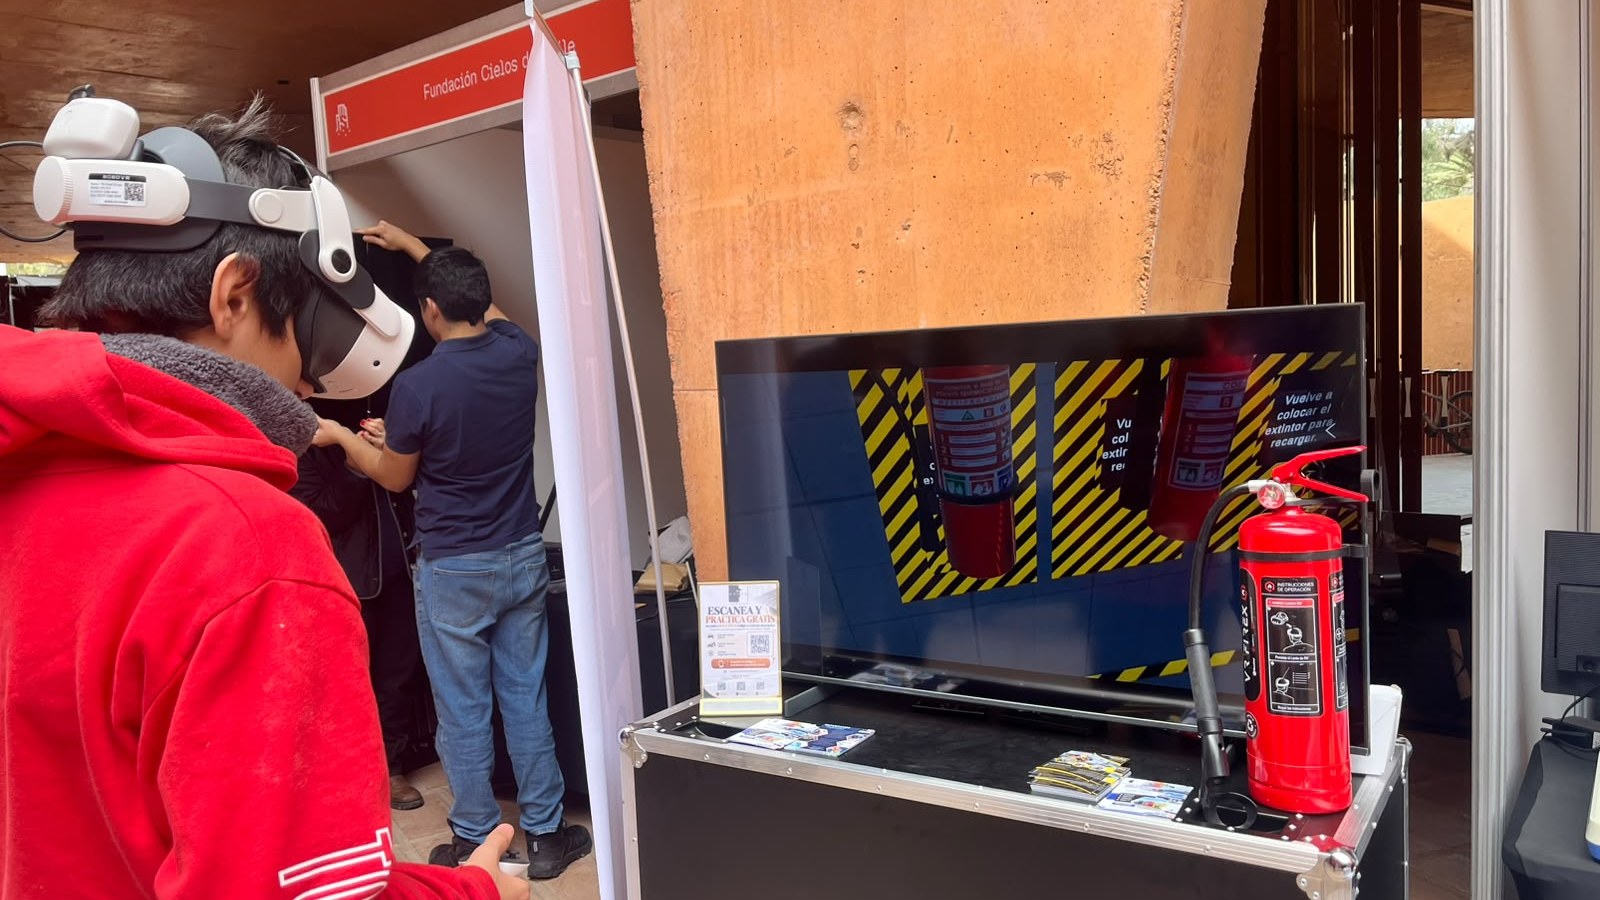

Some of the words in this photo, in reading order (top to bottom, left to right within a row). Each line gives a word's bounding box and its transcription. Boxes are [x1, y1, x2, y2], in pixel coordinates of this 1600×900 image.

[423, 70, 478, 100] Fundación
[481, 59, 518, 82] Cielos
[521, 51, 530, 68] d
[1285, 392, 1322, 406] Vuelve
[1325, 391, 1333, 400] a
[1276, 407, 1318, 421] colocar
[1320, 402, 1332, 415] el
[1116, 418, 1132, 430] Vu
[1264, 422, 1307, 436] extintor
[1308, 418, 1333, 432] para
[1111, 431, 1129, 445] col
[708, 606, 753, 615] ESCANEA
[754, 605, 763, 615] Y
[747, 614, 776, 623] GRATIS
[1241, 604, 1250, 655] FIREX
[1243, 660, 1251, 682] VR
